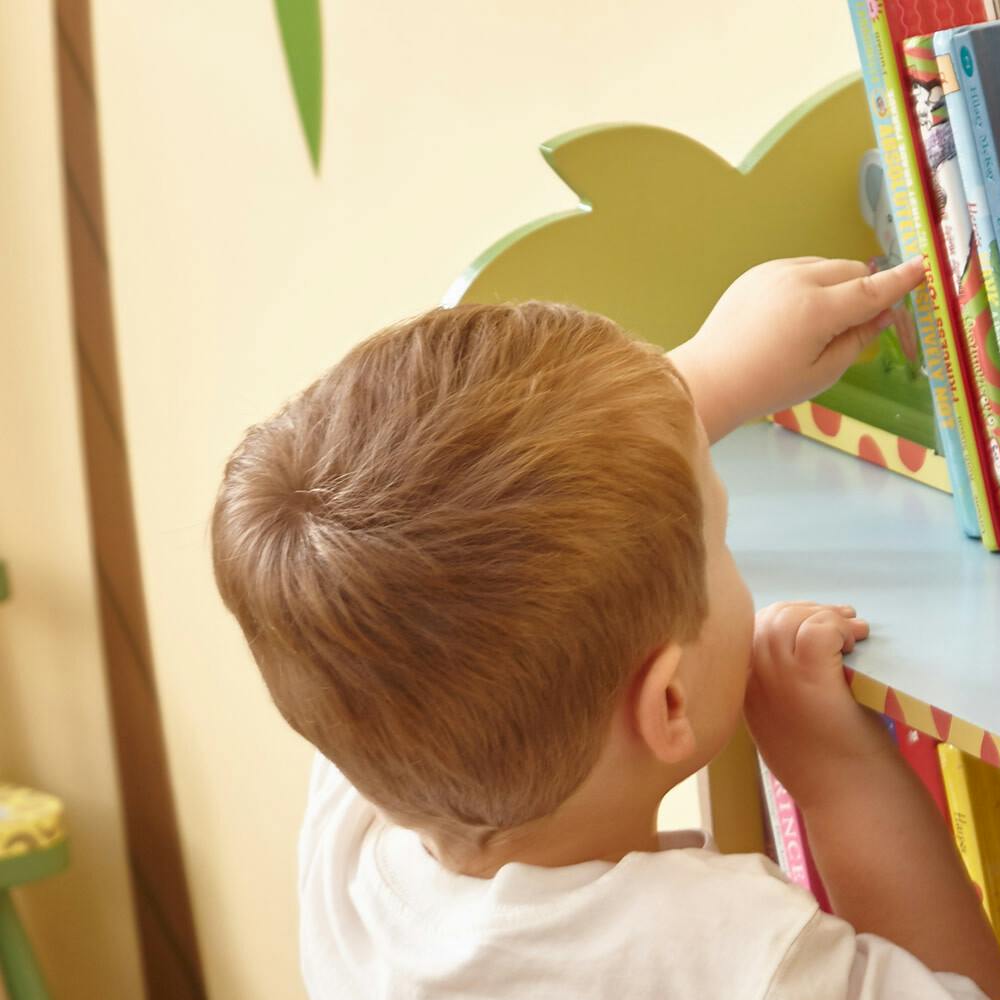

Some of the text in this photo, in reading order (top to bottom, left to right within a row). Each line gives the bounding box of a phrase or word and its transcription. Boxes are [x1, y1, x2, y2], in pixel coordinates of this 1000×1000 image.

[877, 122, 921, 256] ABSOLUTELY
[966, 85, 985, 128] Hilary
[976, 134, 997, 182] McKay
